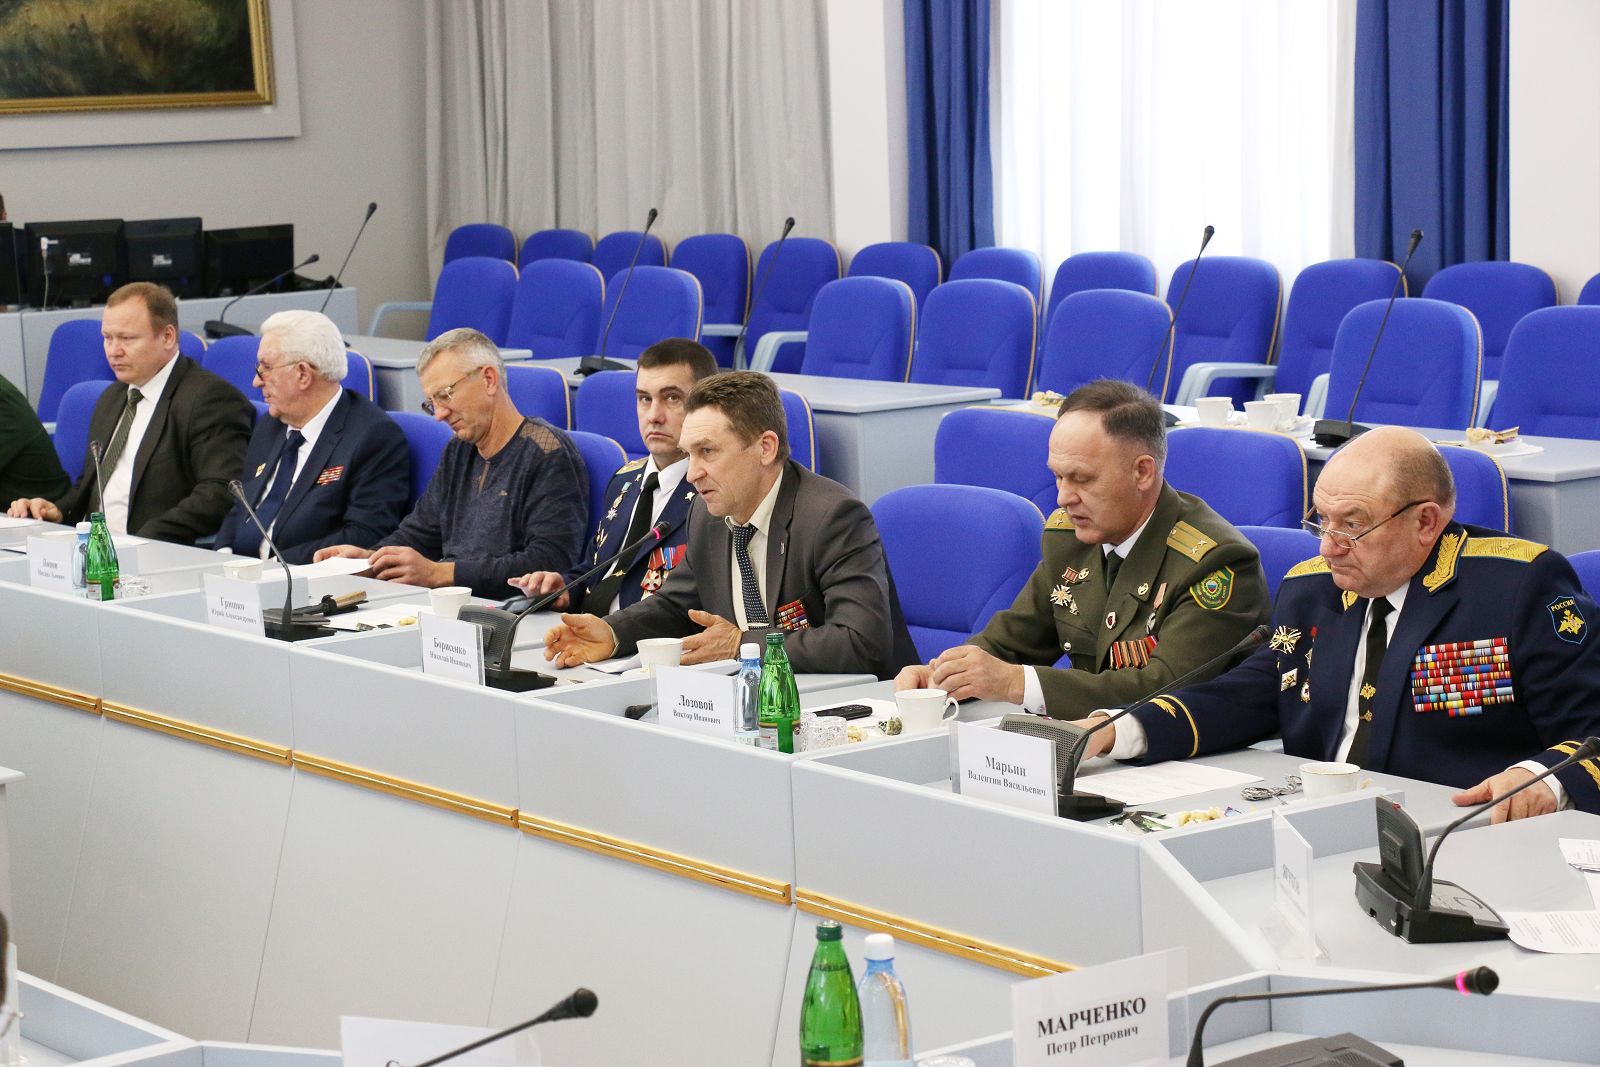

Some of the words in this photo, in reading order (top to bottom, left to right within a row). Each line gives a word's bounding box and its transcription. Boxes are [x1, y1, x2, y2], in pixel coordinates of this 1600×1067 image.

[1551, 599, 1575, 611] РОССИЯ
[433, 637, 467, 655] Борисенко
[678, 694, 714, 711] Лозовой
[673, 709, 693, 721] Виктор
[693, 714, 721, 725] Иванович
[985, 755, 1026, 777] Марьин
[968, 769, 1002, 786] Валентин
[1003, 778, 1046, 797] Васильевич
[1037, 997, 1147, 1037] МАРЧЕНКО
[1046, 1038, 1077, 1056] Петр
[1080, 1026, 1139, 1047] Петрович
